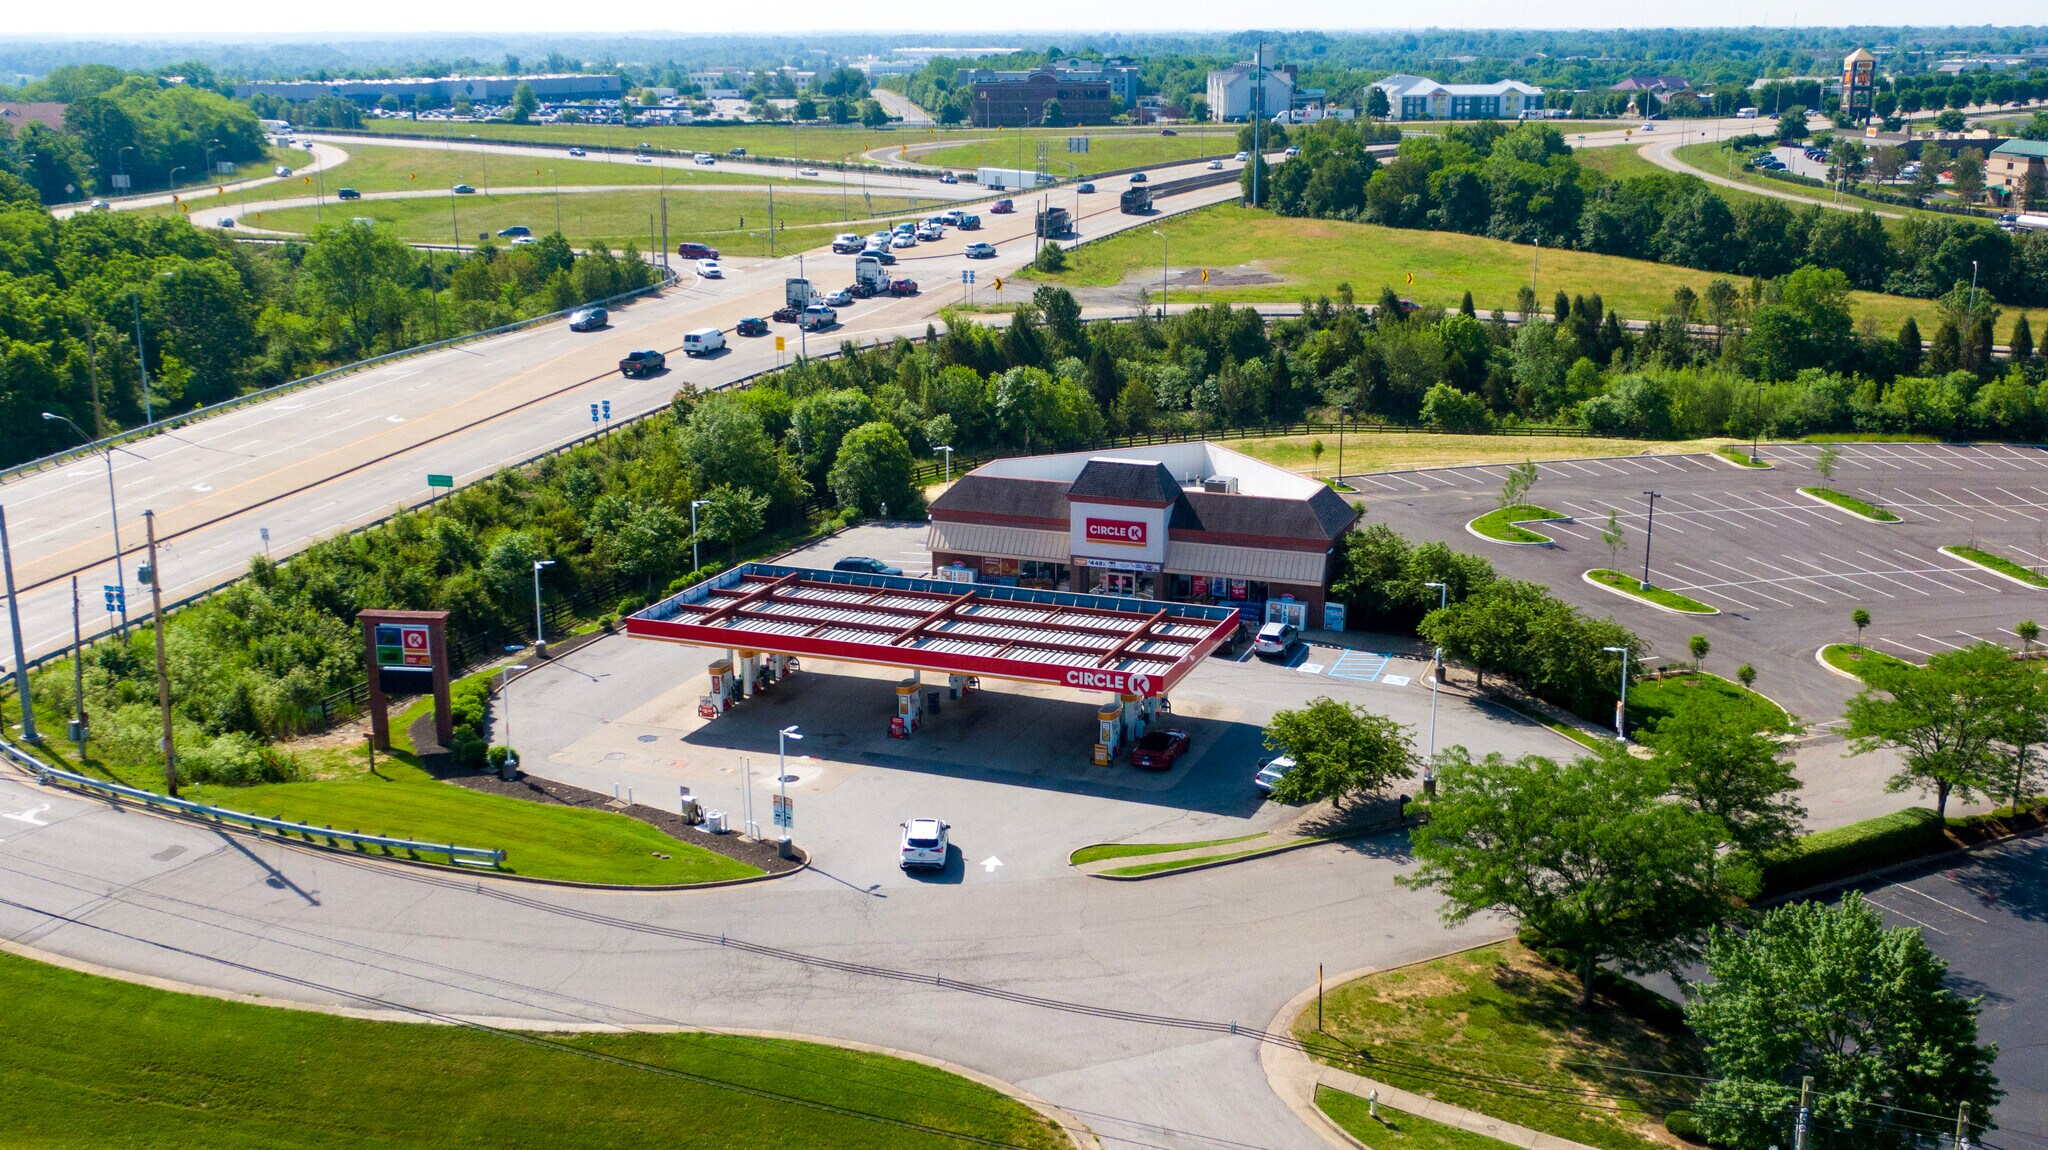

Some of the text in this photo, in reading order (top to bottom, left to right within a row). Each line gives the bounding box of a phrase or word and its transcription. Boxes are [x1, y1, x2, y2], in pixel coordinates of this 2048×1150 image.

[1089, 525, 1141, 540] CIRCLE K
[409, 634, 421, 647] K
[1066, 671, 1149, 695] CIRCLE K
